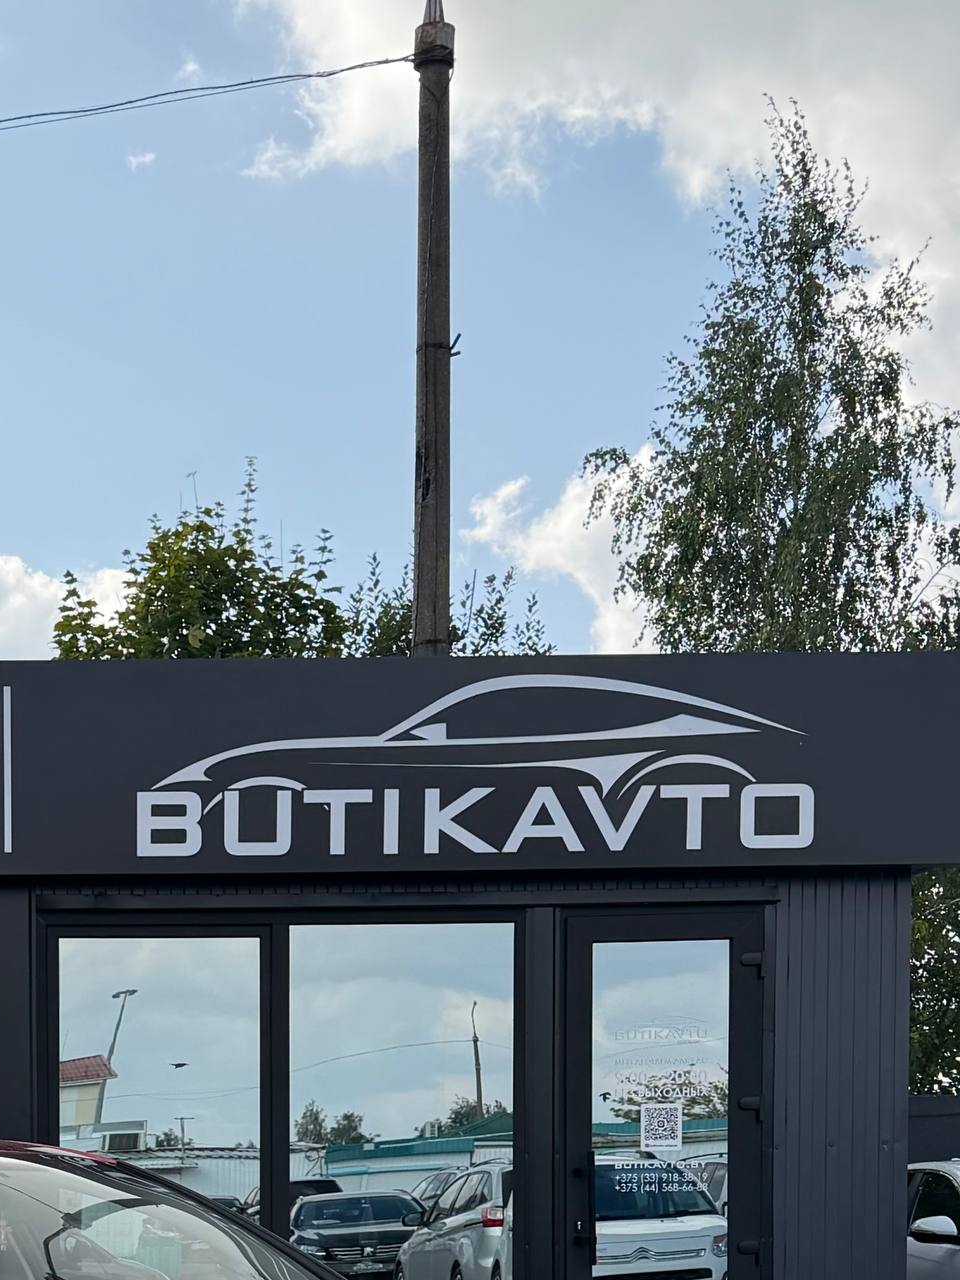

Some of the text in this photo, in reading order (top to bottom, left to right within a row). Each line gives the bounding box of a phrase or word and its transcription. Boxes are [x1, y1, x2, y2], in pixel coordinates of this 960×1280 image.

[136, 783, 815, 857] BUTIKAVTO
[615, 1173, 638, 1182] +375
[640, 1172, 659, 1185] (33)
[615, 1183, 638, 1192] +375
[640, 1182, 659, 1194] (44)
